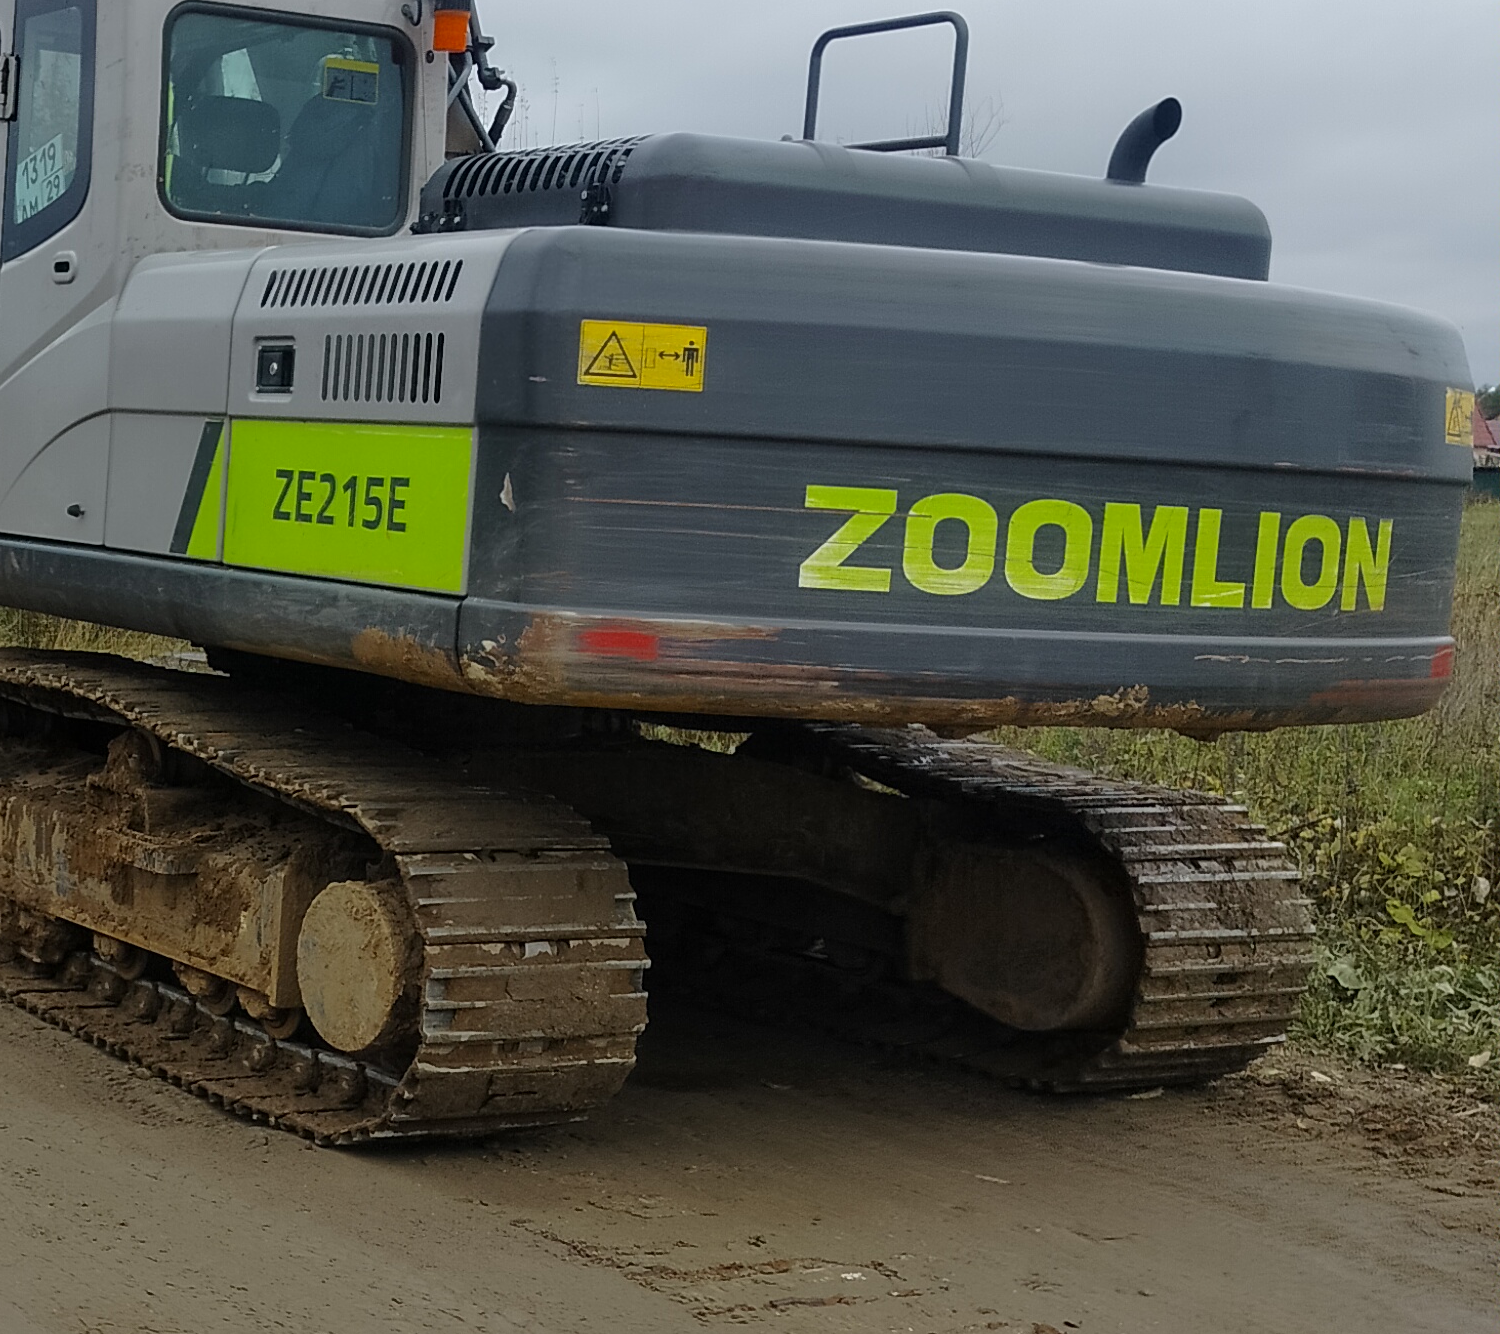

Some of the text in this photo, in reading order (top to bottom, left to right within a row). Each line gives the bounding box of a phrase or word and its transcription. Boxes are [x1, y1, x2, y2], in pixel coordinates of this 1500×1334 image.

[21, 142, 56, 190] 1319
[46, 174, 60, 203] 29
[272, 469, 410, 533] ZE215E
[798, 484, 1394, 612] ZOOMLION
